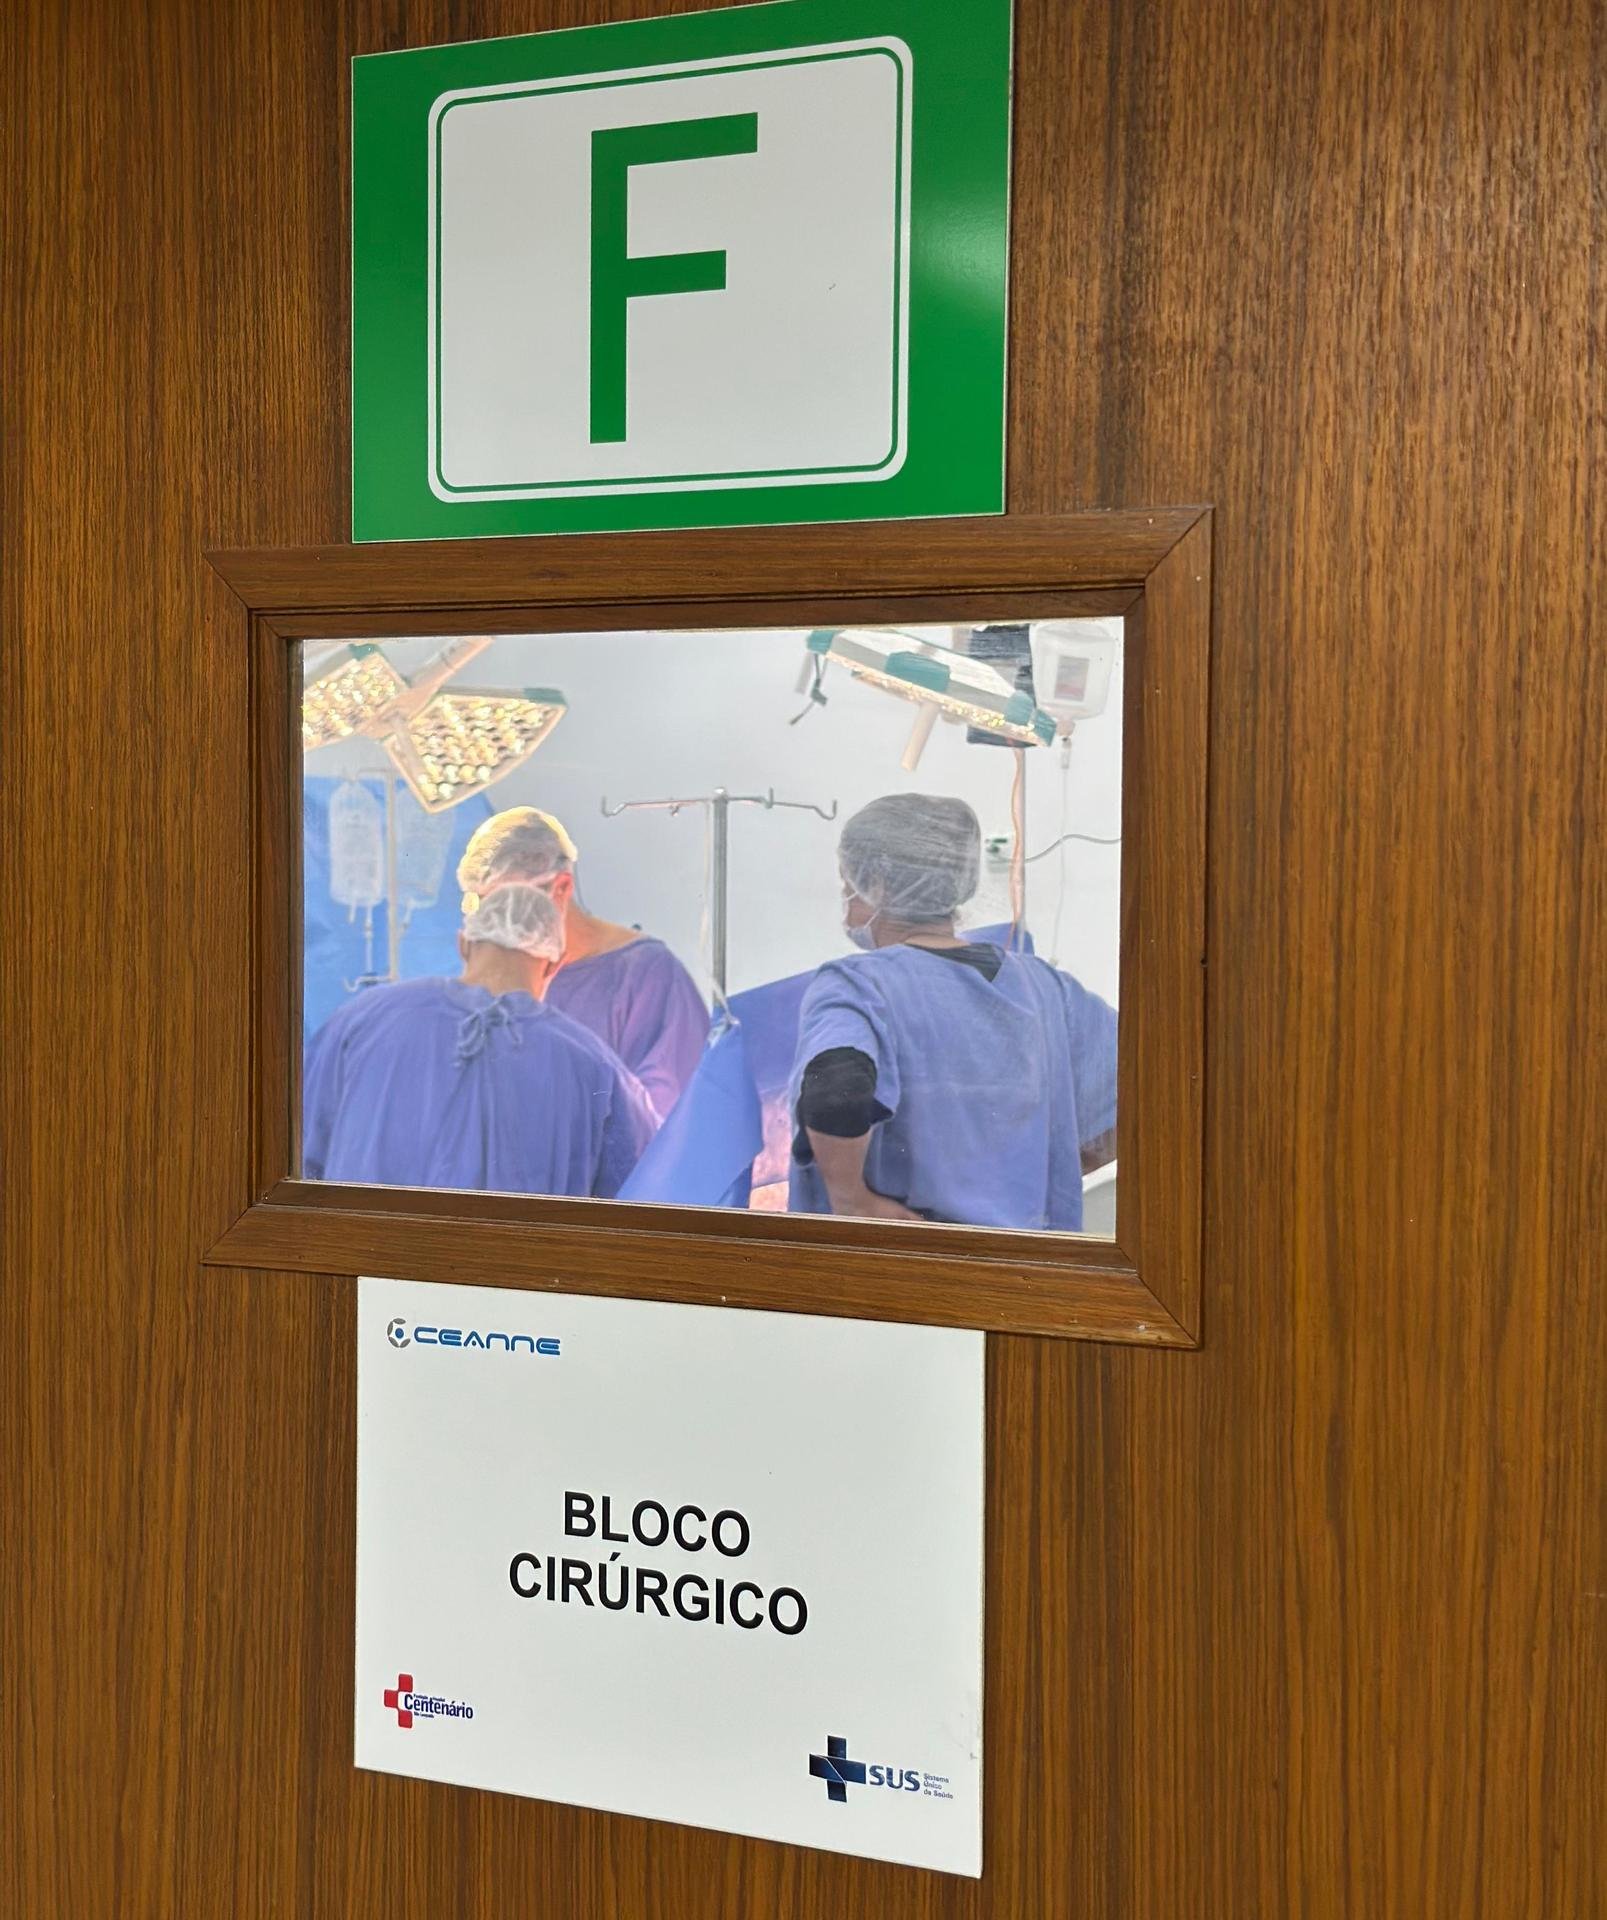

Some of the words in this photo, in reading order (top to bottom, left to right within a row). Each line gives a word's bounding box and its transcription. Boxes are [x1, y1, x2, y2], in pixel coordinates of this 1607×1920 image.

[589, 111, 759, 444] F
[564, 1490, 750, 1557] BLOCO
[509, 1551, 808, 1635] CIRÚRGICO
[404, 1693, 474, 1719] Centenário
[868, 1764, 921, 1792] SUS
